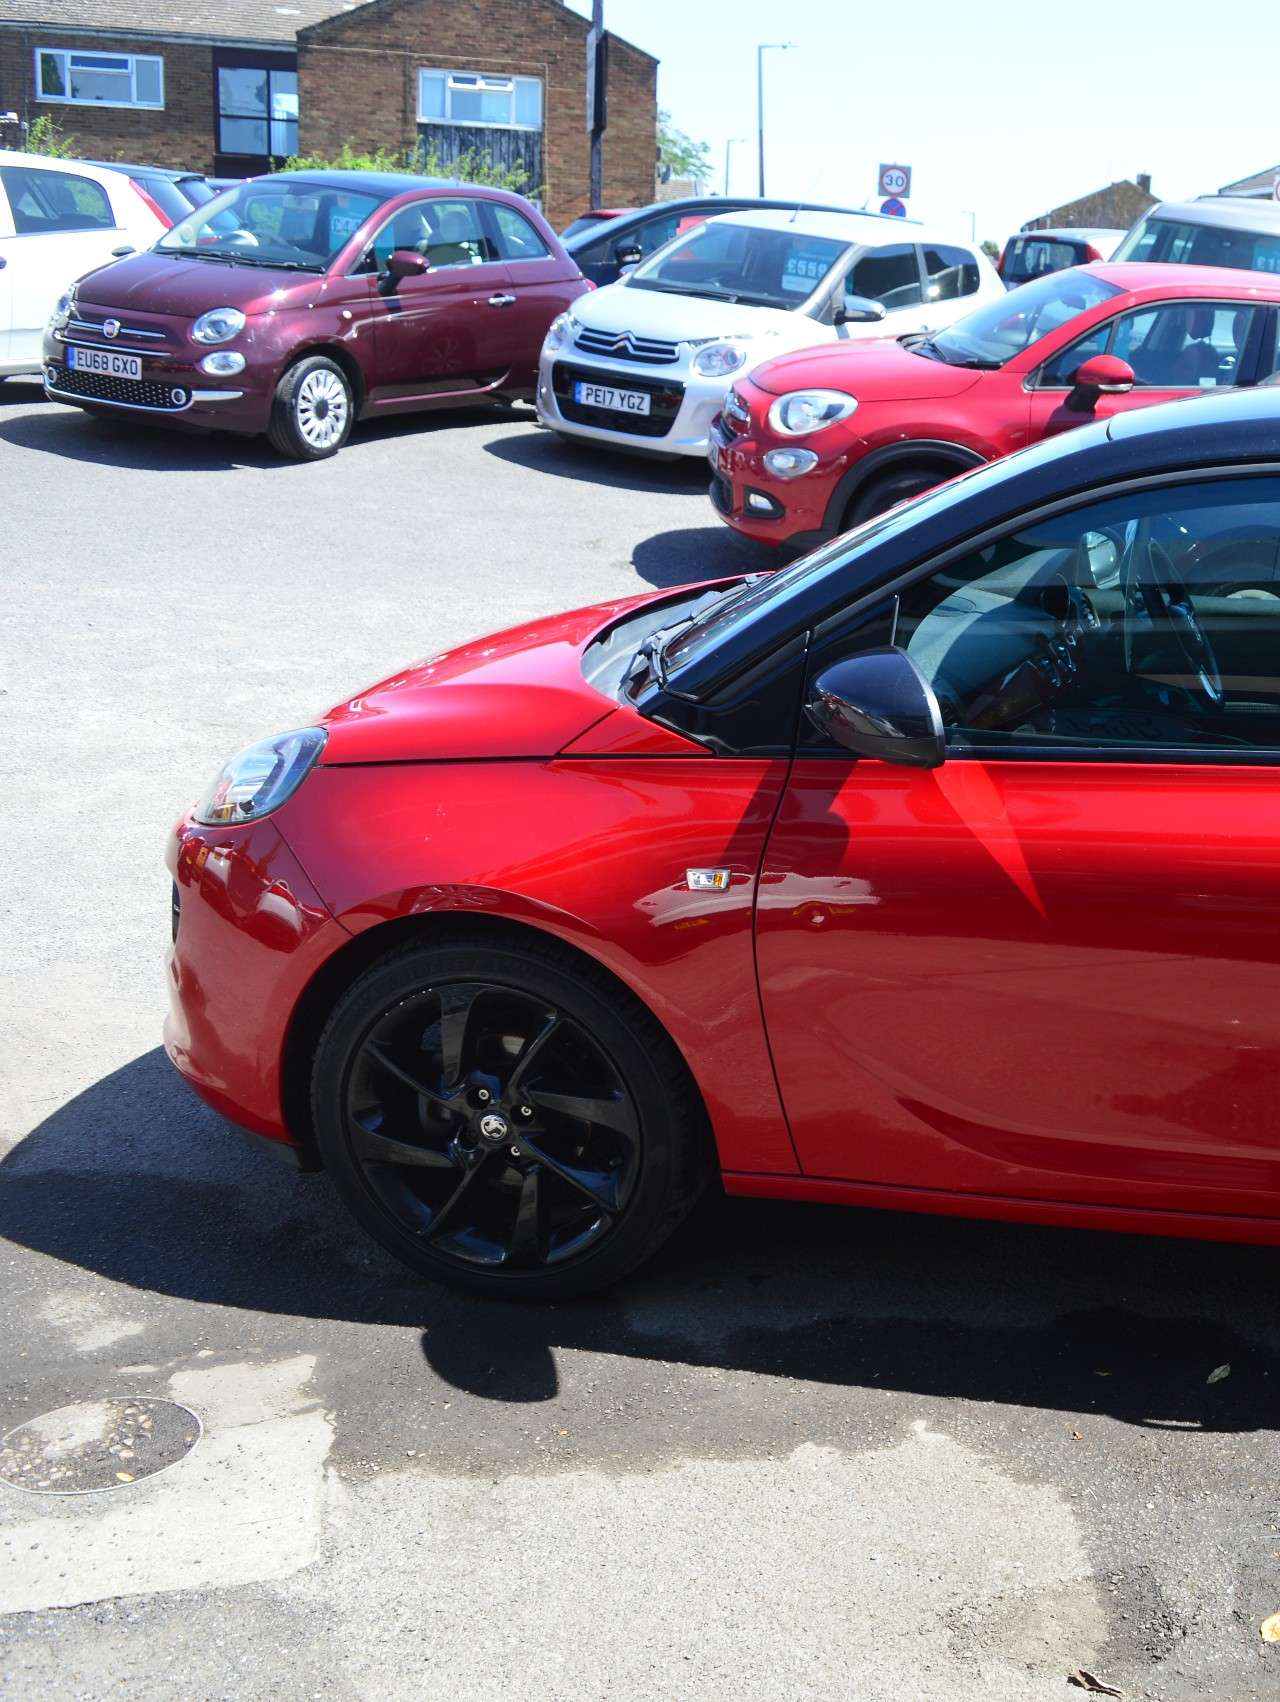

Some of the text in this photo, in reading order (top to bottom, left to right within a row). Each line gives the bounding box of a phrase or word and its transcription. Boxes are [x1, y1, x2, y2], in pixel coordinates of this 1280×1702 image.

[885, 174, 905, 187] 30
[77, 351, 138, 376] EU68 GXO
[585, 386, 645, 411] PE17 YGZ
